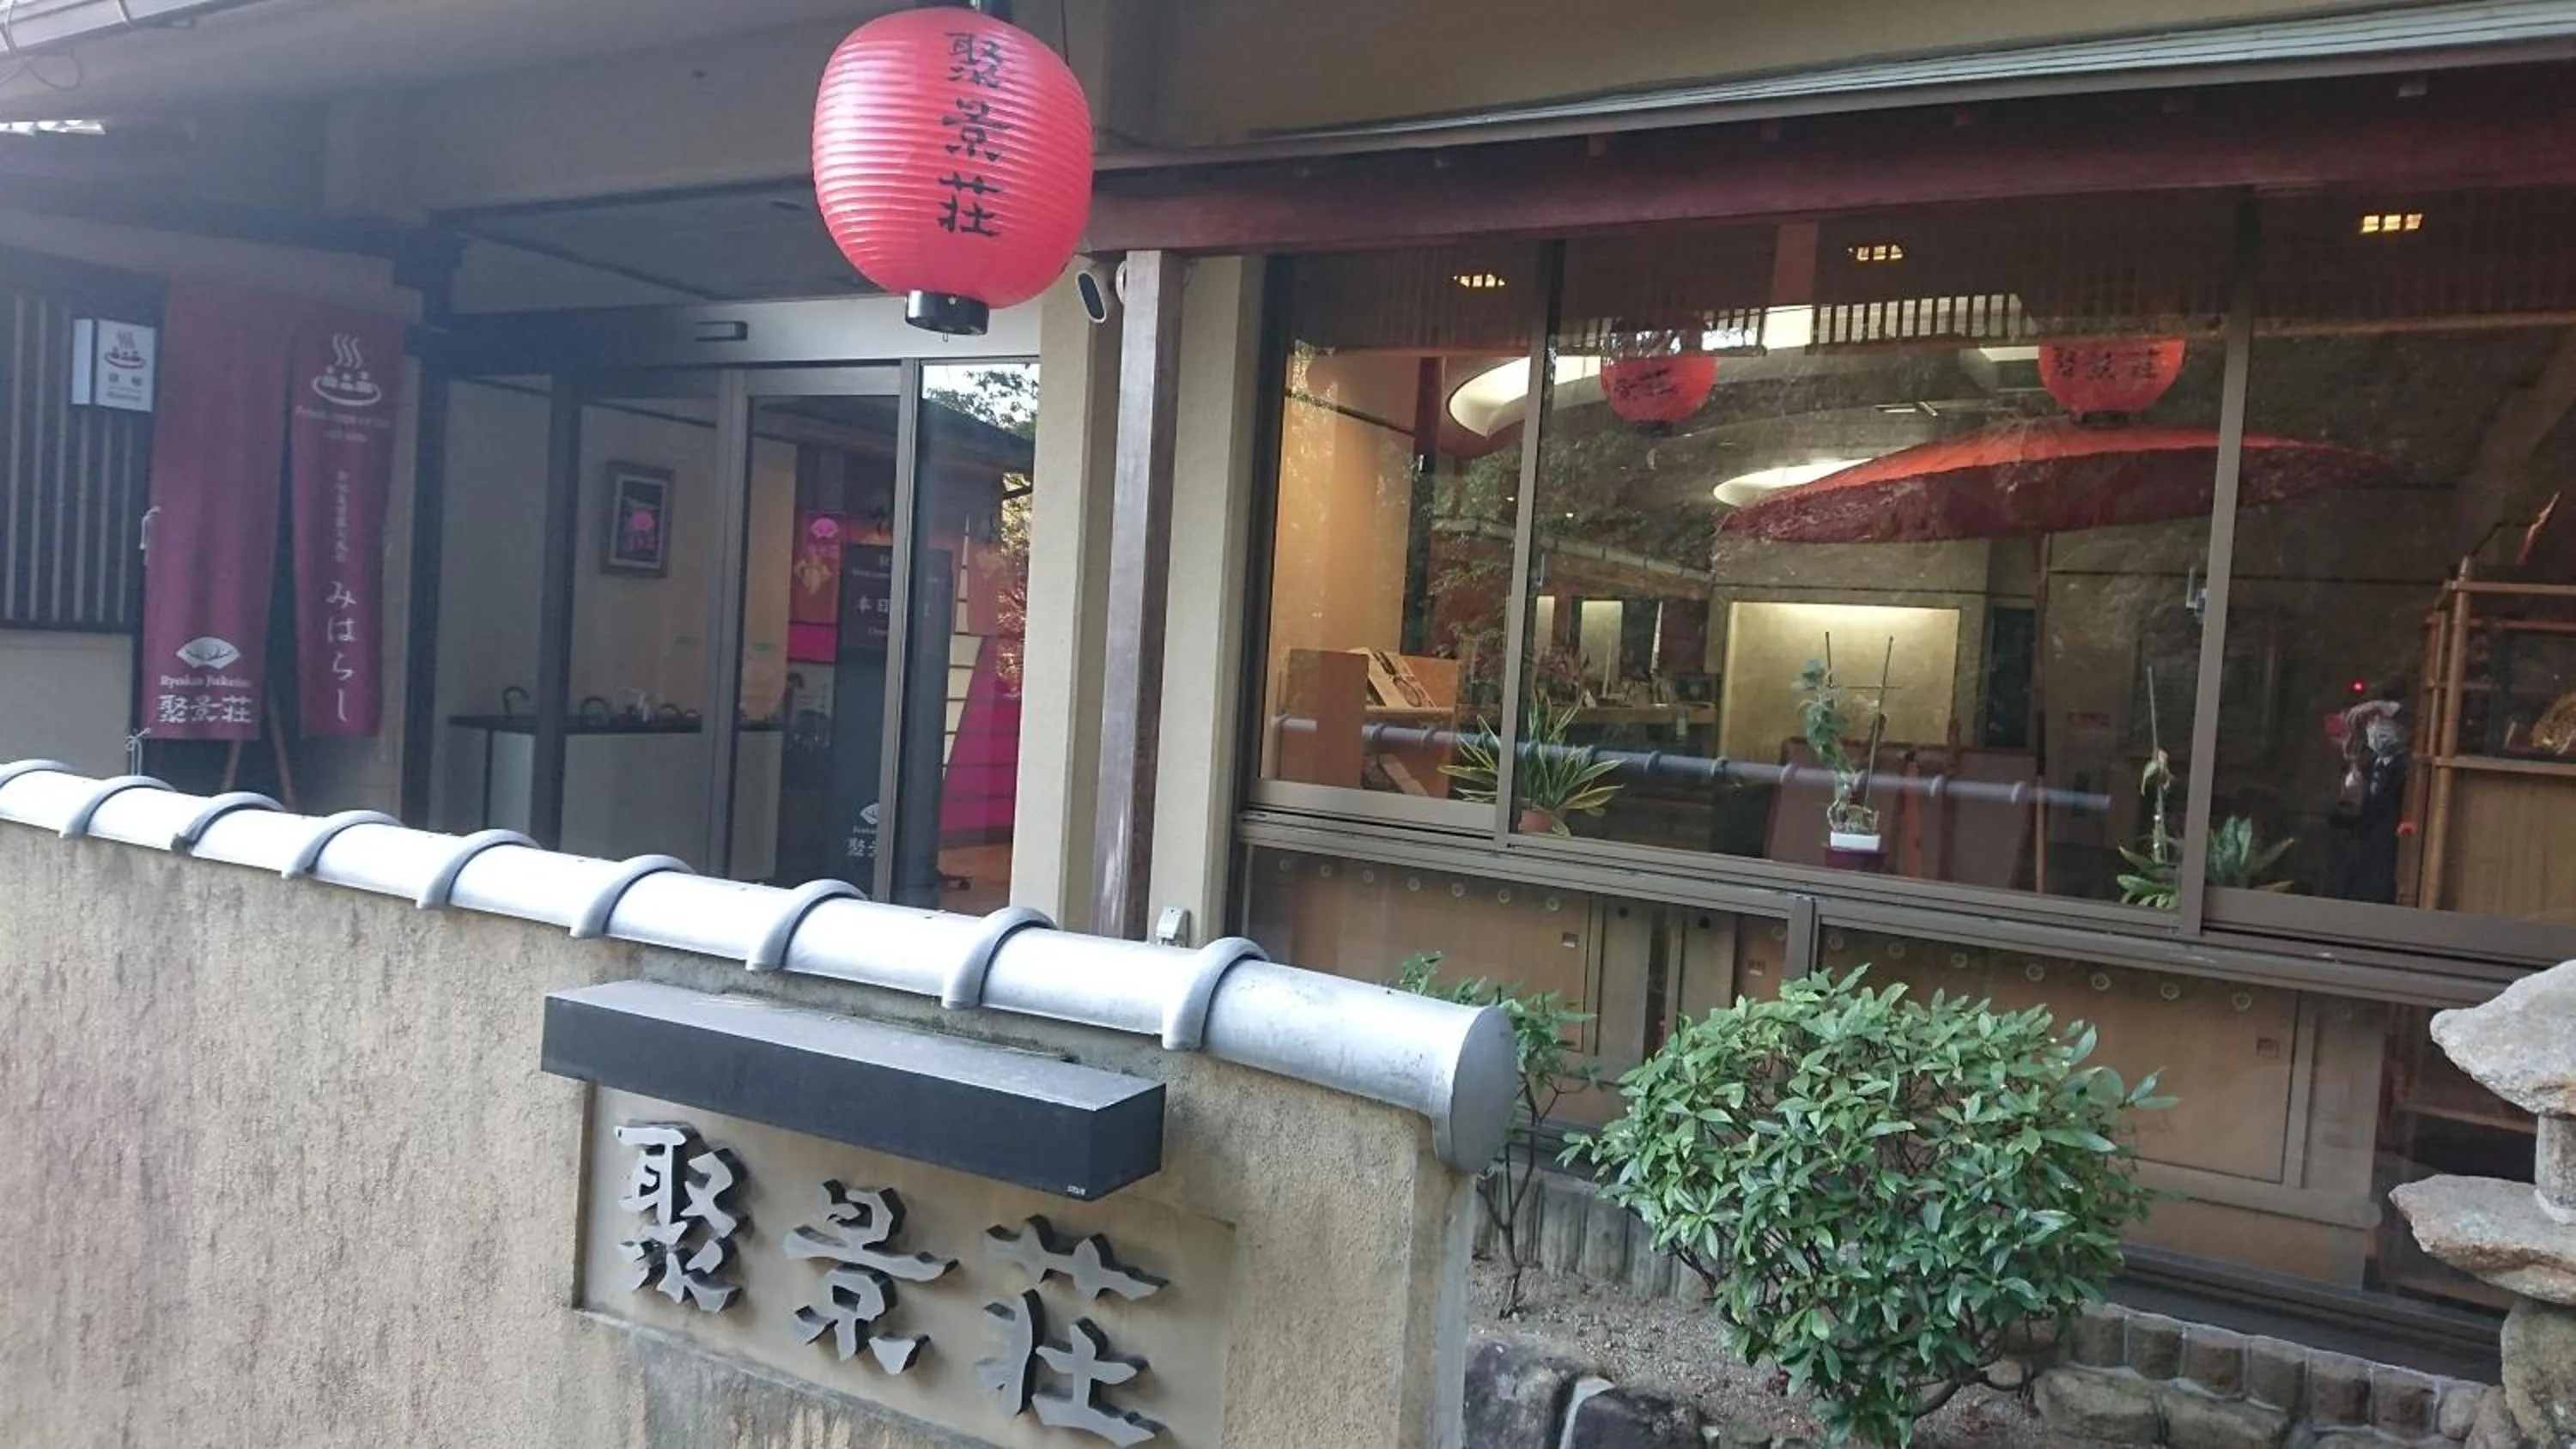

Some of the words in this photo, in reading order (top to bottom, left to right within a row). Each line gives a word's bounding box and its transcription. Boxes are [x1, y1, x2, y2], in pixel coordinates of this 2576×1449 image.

[938, 33, 1013, 238] 聚景荘
[157, 694, 253, 724] 聚景荘
[326, 580, 358, 723] みはらし
[613, 1122, 1170, 1446] 聚景荘
